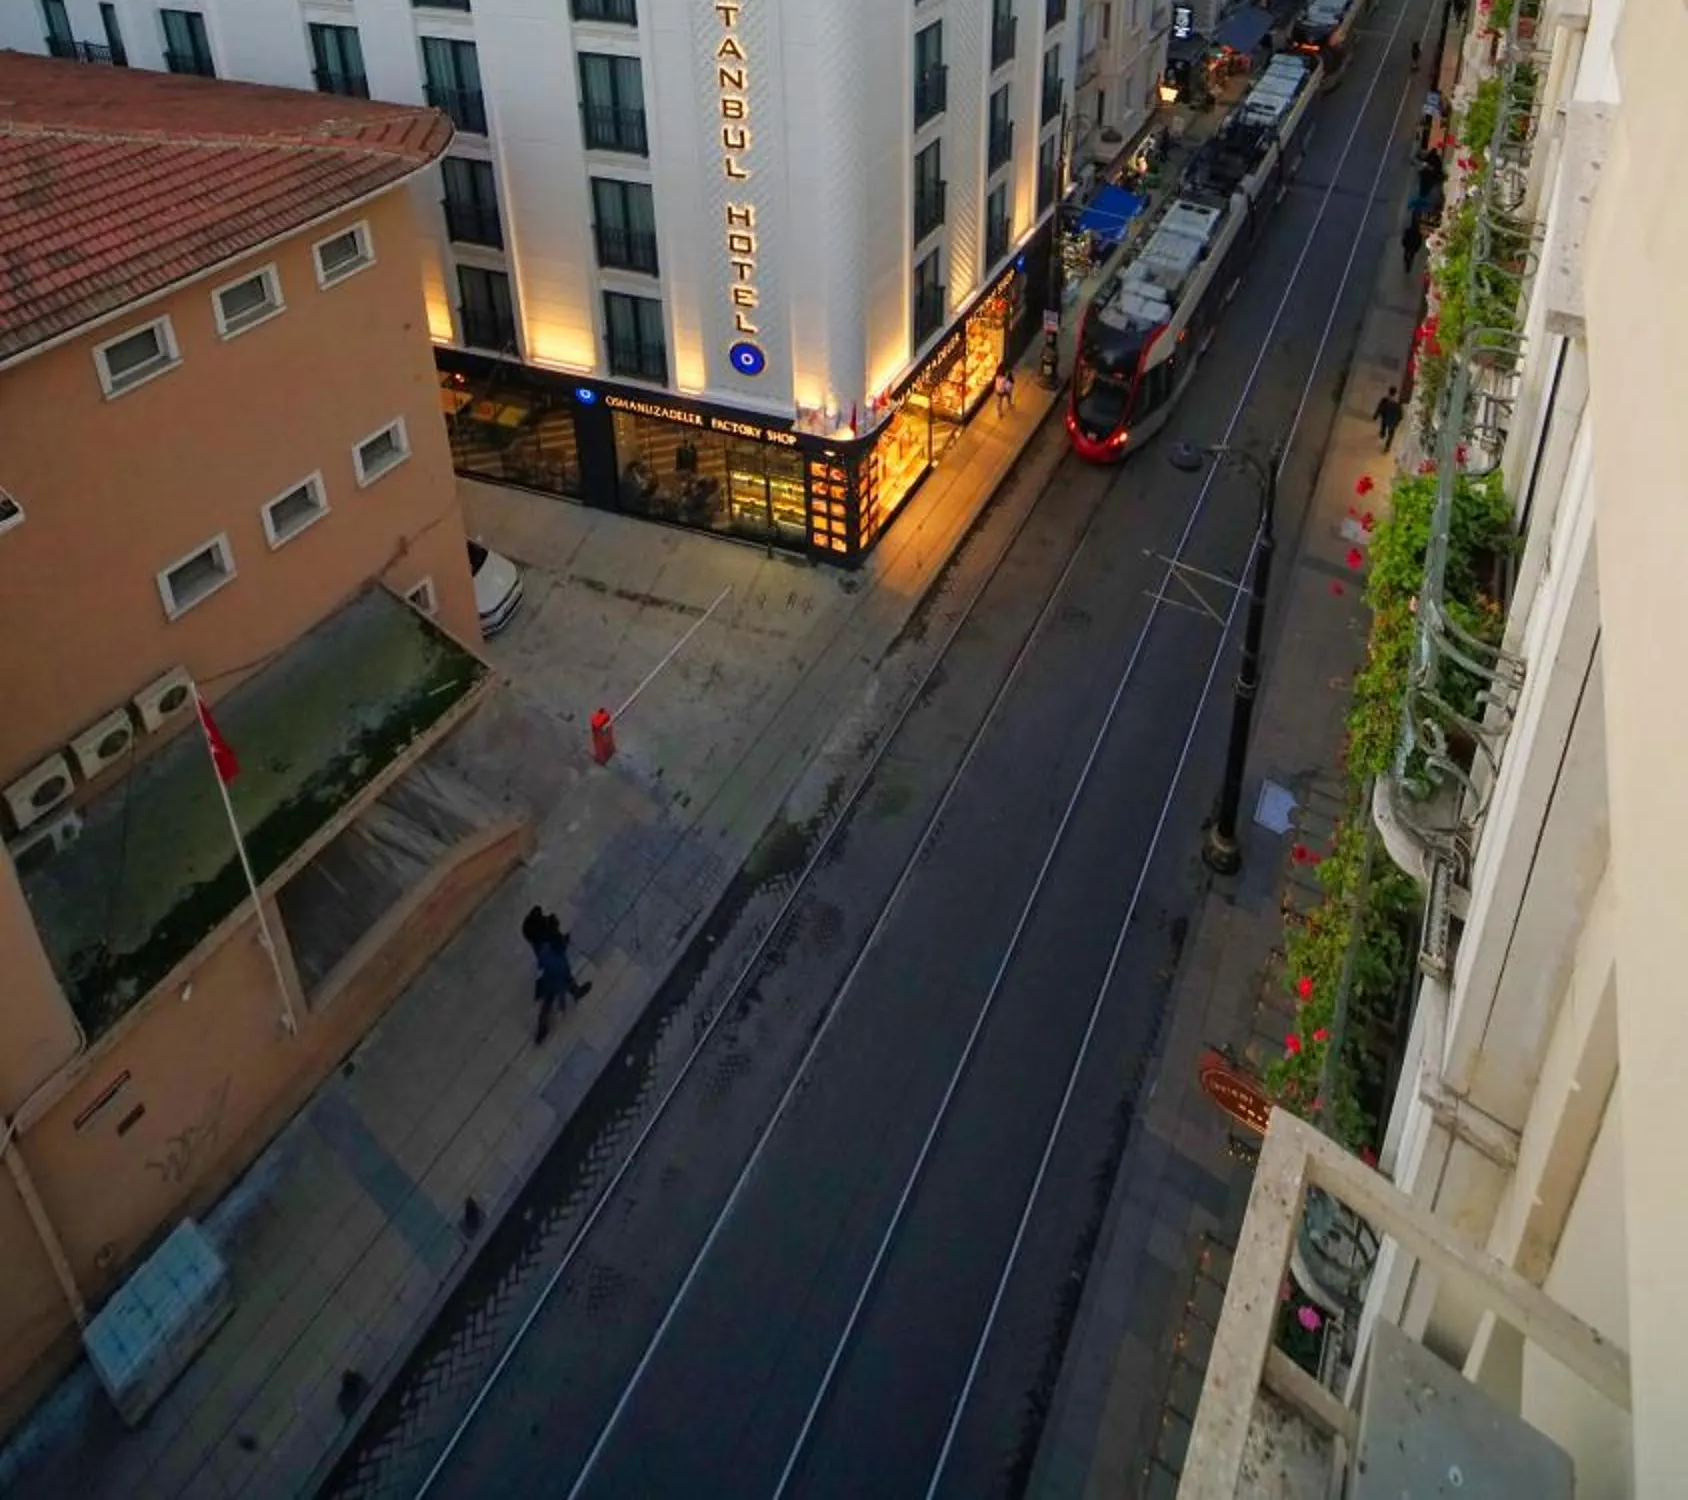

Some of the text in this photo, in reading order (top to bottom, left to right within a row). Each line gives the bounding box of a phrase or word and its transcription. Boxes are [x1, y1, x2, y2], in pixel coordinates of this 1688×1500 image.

[727, 206, 756, 334] HOTEL
[711, 417, 762, 439] FACTORY
[766, 429, 797, 446] SHOP
